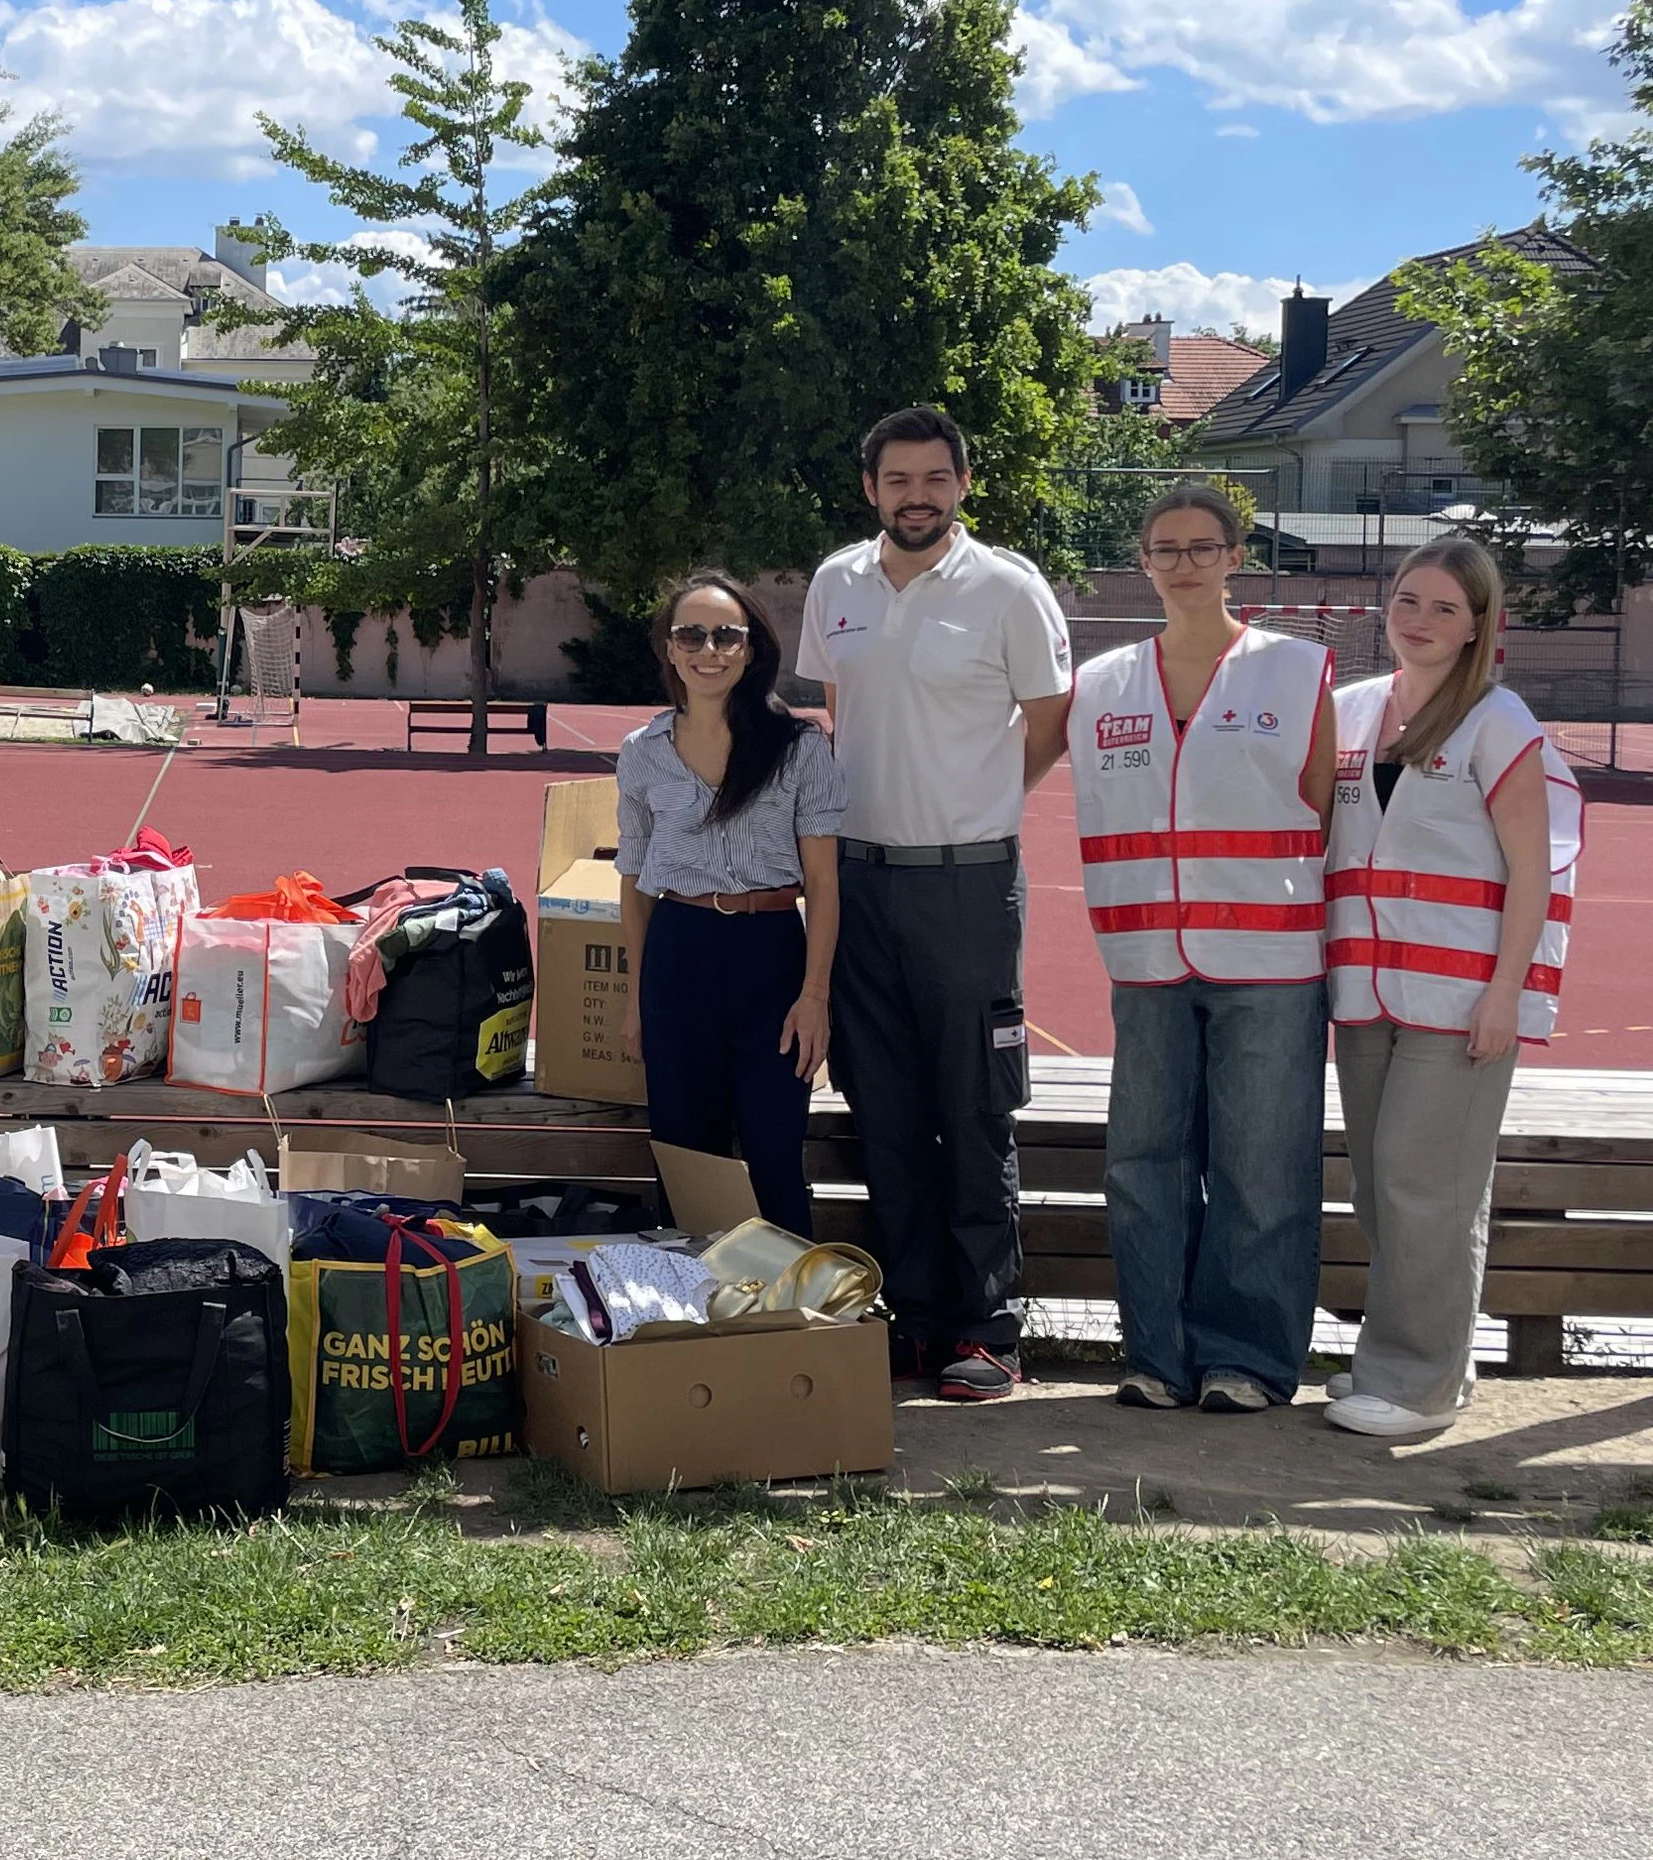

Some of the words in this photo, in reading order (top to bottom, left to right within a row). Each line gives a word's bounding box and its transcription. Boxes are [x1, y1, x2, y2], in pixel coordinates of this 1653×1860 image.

[1100, 717, 1151, 739] TEAM
[47, 920, 68, 993] ACTION
[583, 981, 609, 992] ITEM
[234, 970, 244, 1044] www.mueller.eu
[323, 1331, 411, 1361] GANZ
